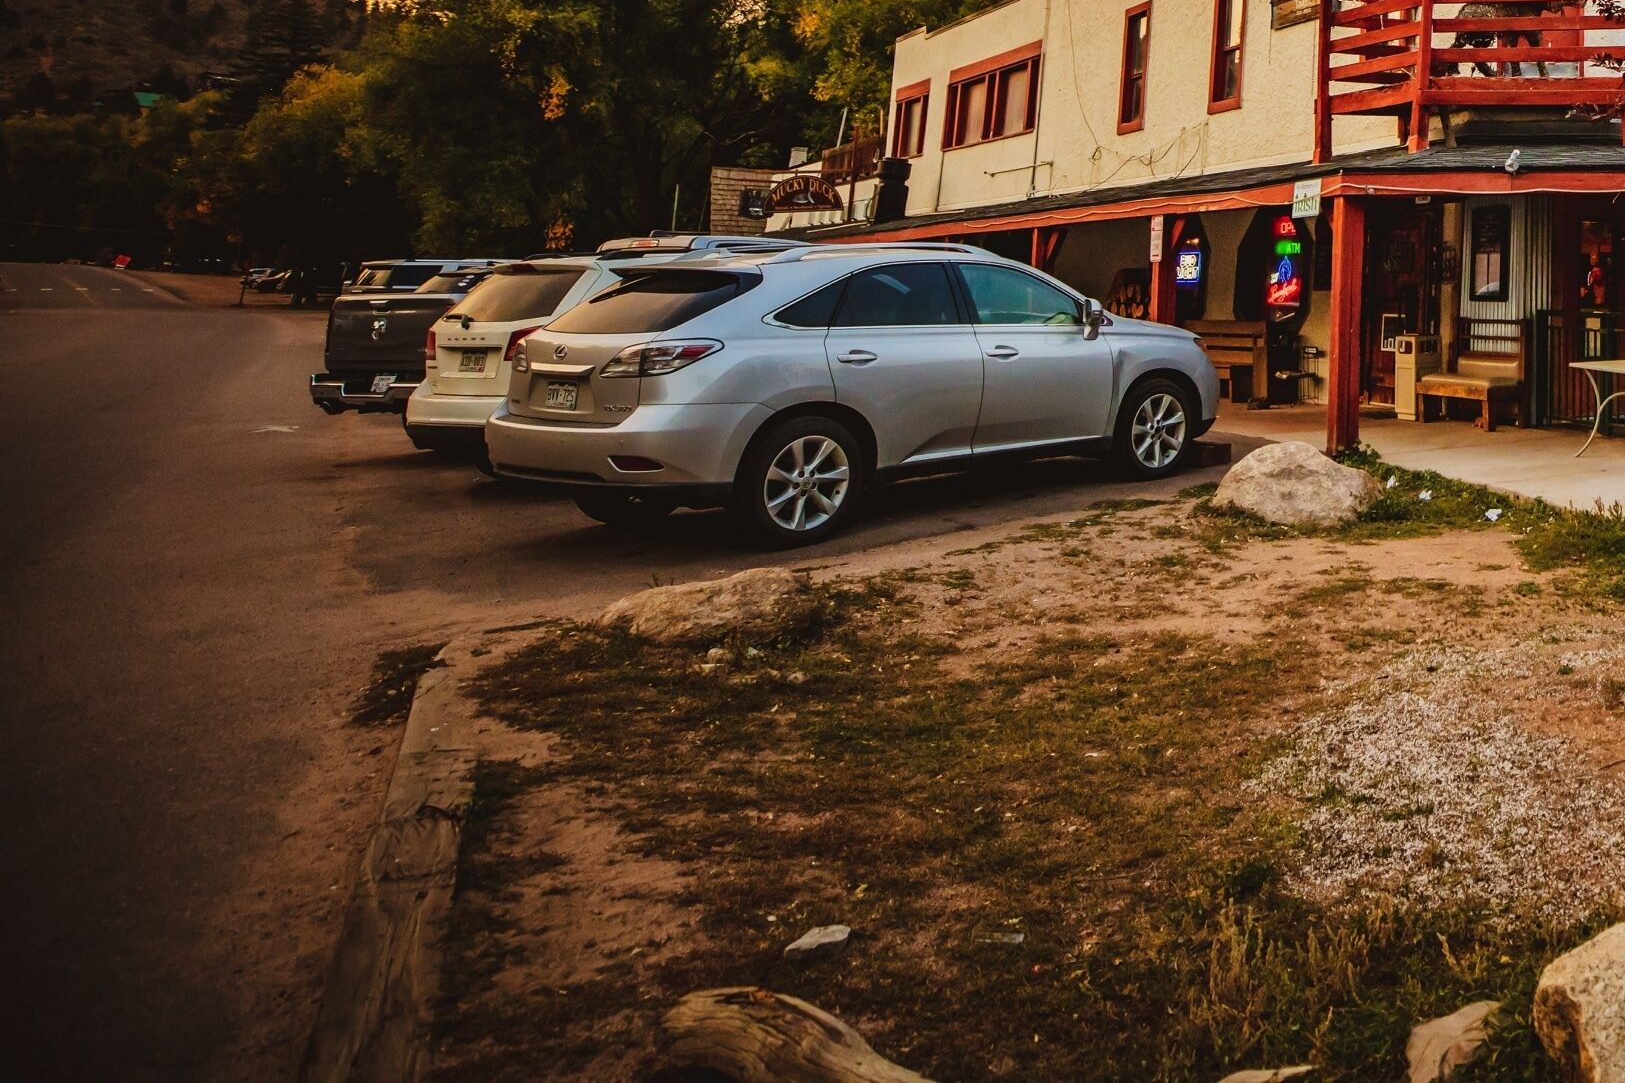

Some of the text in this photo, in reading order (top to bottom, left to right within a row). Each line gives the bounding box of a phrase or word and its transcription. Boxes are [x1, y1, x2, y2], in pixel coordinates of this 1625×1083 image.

[772, 178, 835, 204] MUCKY DUCK
[1285, 242, 1301, 254] ATM
[1179, 254, 1197, 267] BUD
